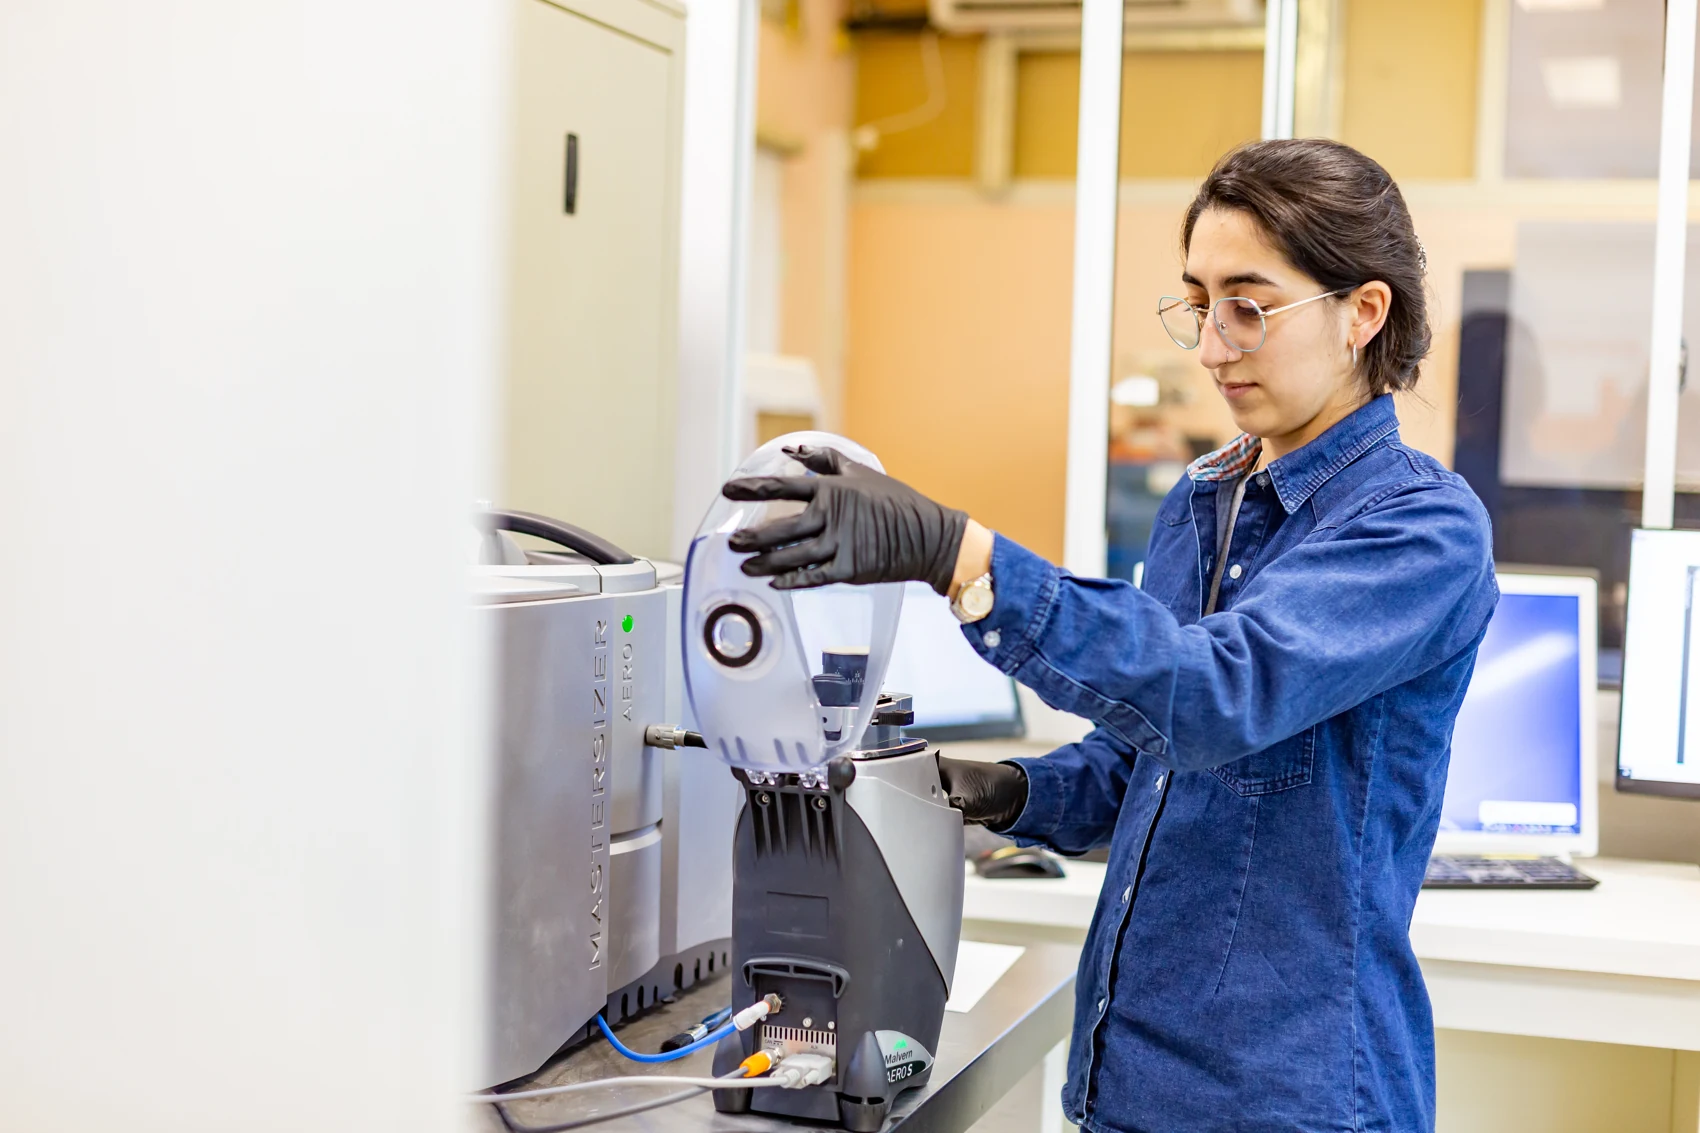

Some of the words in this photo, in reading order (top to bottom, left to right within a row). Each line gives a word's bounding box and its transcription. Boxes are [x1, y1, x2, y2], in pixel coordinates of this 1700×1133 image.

[622, 643, 633, 721] AERO
[589, 619, 608, 970] MASTERSIZER
[884, 1049, 913, 1065] Malvern
[906, 1063, 913, 1077] S
